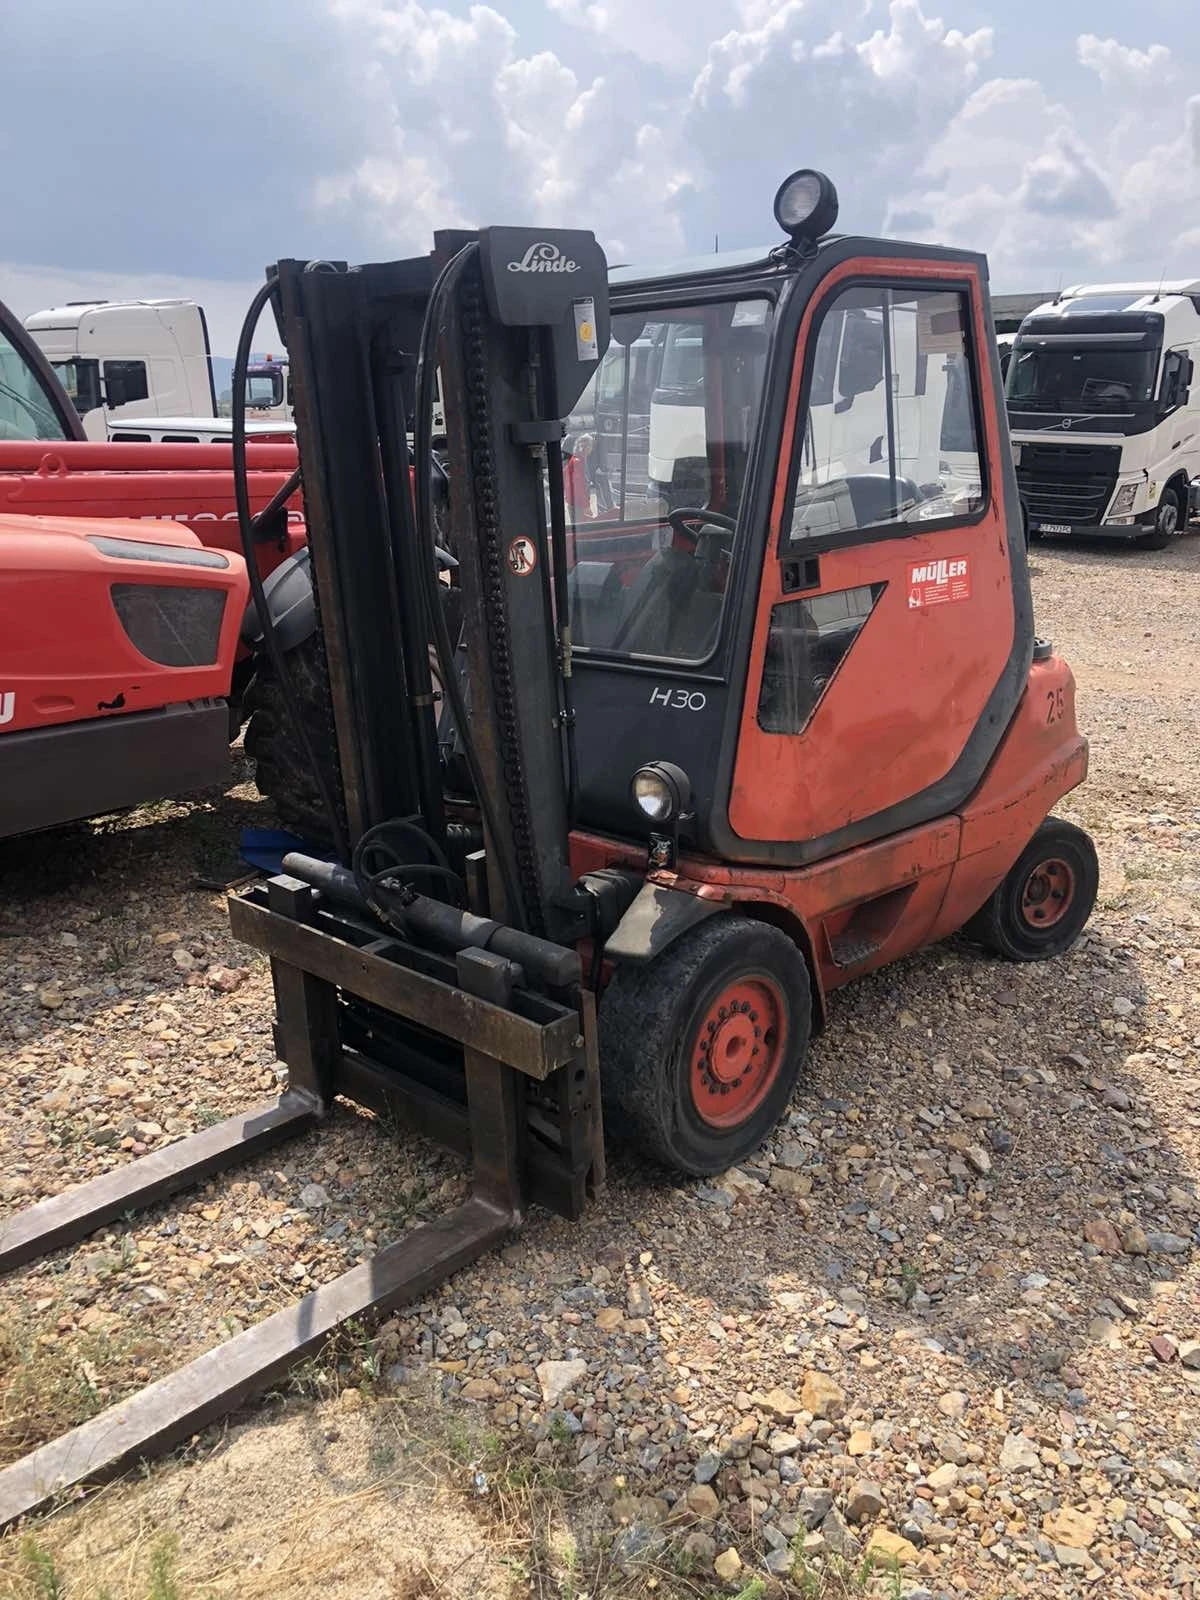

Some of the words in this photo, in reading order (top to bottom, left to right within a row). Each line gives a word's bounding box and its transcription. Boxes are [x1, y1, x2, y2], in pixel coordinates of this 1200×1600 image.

[507, 242, 581, 273] Linde
[911, 559, 967, 585] MÜLLER
[649, 687, 706, 711] H30
